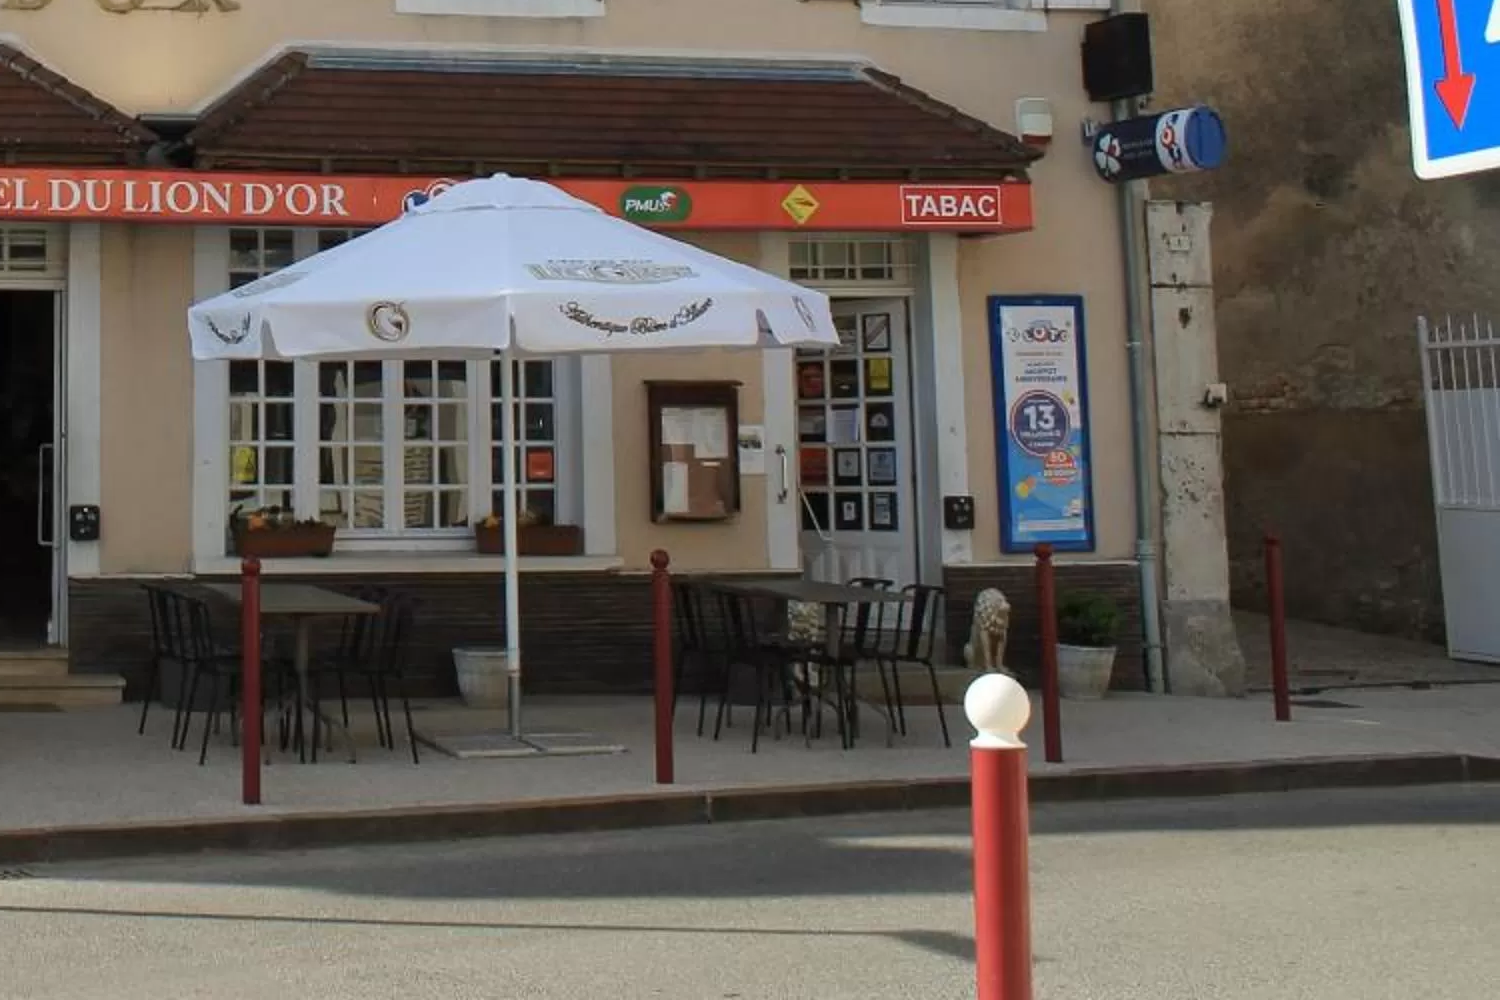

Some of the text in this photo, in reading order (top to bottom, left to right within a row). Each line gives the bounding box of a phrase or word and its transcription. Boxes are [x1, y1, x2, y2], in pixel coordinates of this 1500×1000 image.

[47, 178, 115, 212] DU
[123, 179, 233, 215] LION
[241, 183, 349, 217] D'OR
[625, 198, 659, 212] PMU
[905, 194, 997, 218] TABAC
[1023, 404, 1056, 430] 13
